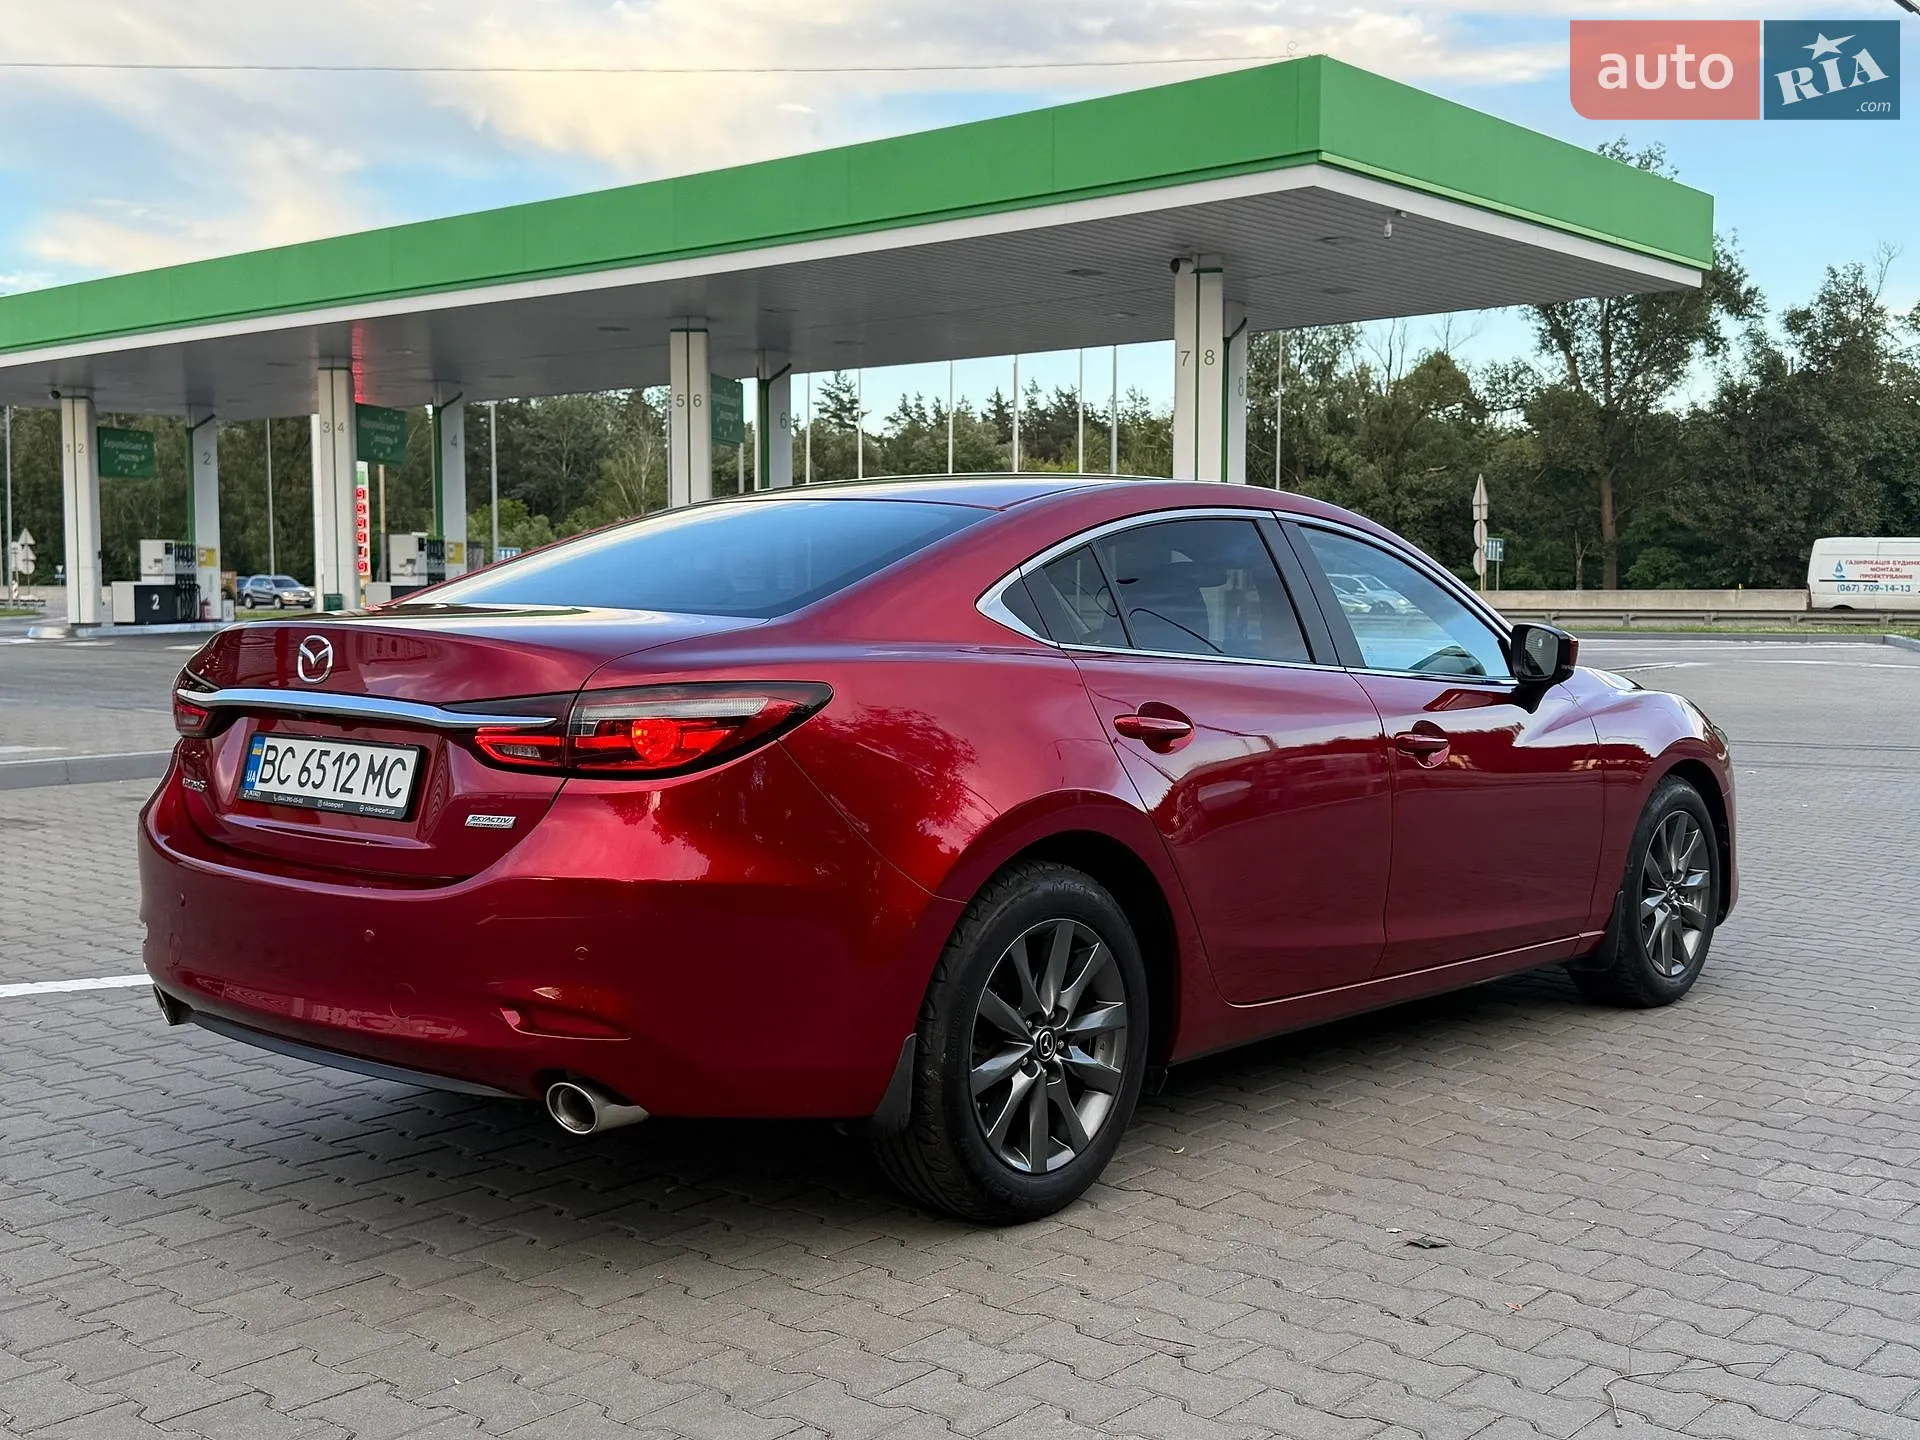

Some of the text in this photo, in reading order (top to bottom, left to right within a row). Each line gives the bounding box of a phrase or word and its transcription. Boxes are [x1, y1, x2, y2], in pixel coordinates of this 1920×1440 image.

[1180, 349, 1215, 367] 7 8
[1238, 376, 1244, 397] 8
[676, 394, 685, 408] 5
[693, 394, 702, 408] 6
[322, 421, 345, 433] 3 4
[780, 411, 787, 430] 6
[450, 434, 458, 448] 4
[66, 443, 85, 454] 1 2
[202, 452, 212, 466] 2
[1837, 583, 1911, 593] (067) 709-14-13
[152, 594, 160, 610] 2
[246, 770, 256, 783] UA
[258, 744, 407, 799] BC 6512 MC
